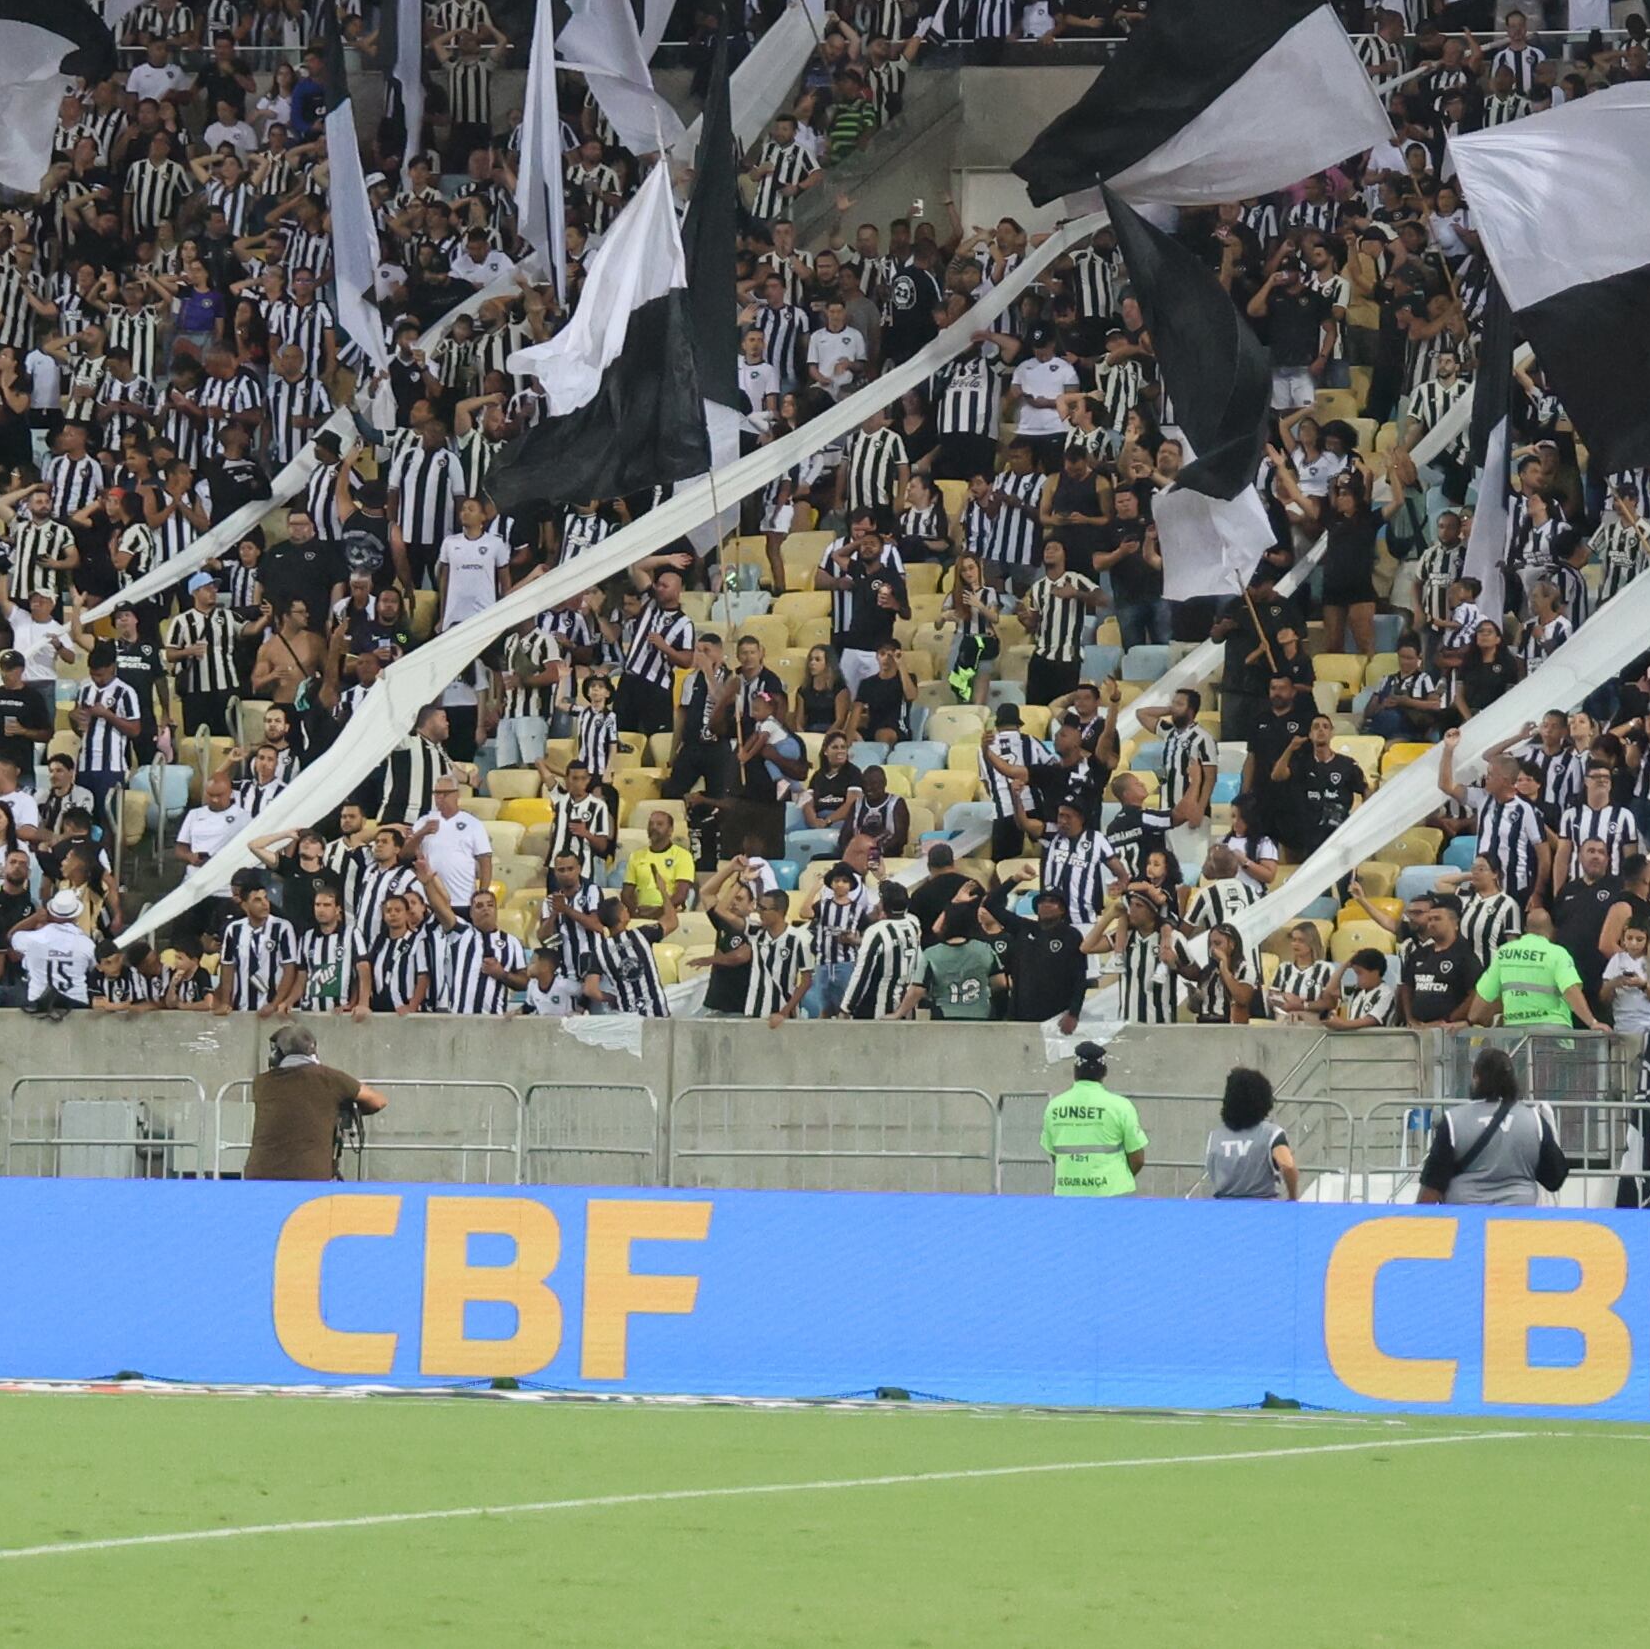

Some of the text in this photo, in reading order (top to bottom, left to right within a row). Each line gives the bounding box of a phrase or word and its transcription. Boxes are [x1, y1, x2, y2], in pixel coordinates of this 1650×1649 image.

[1498, 949, 1547, 962] SUNSET
[47, 959, 74, 992] 15
[1052, 1106, 1106, 1120] SUNSET
[1220, 1140, 1254, 1157] TV
[272, 1194, 714, 1380] CBF
